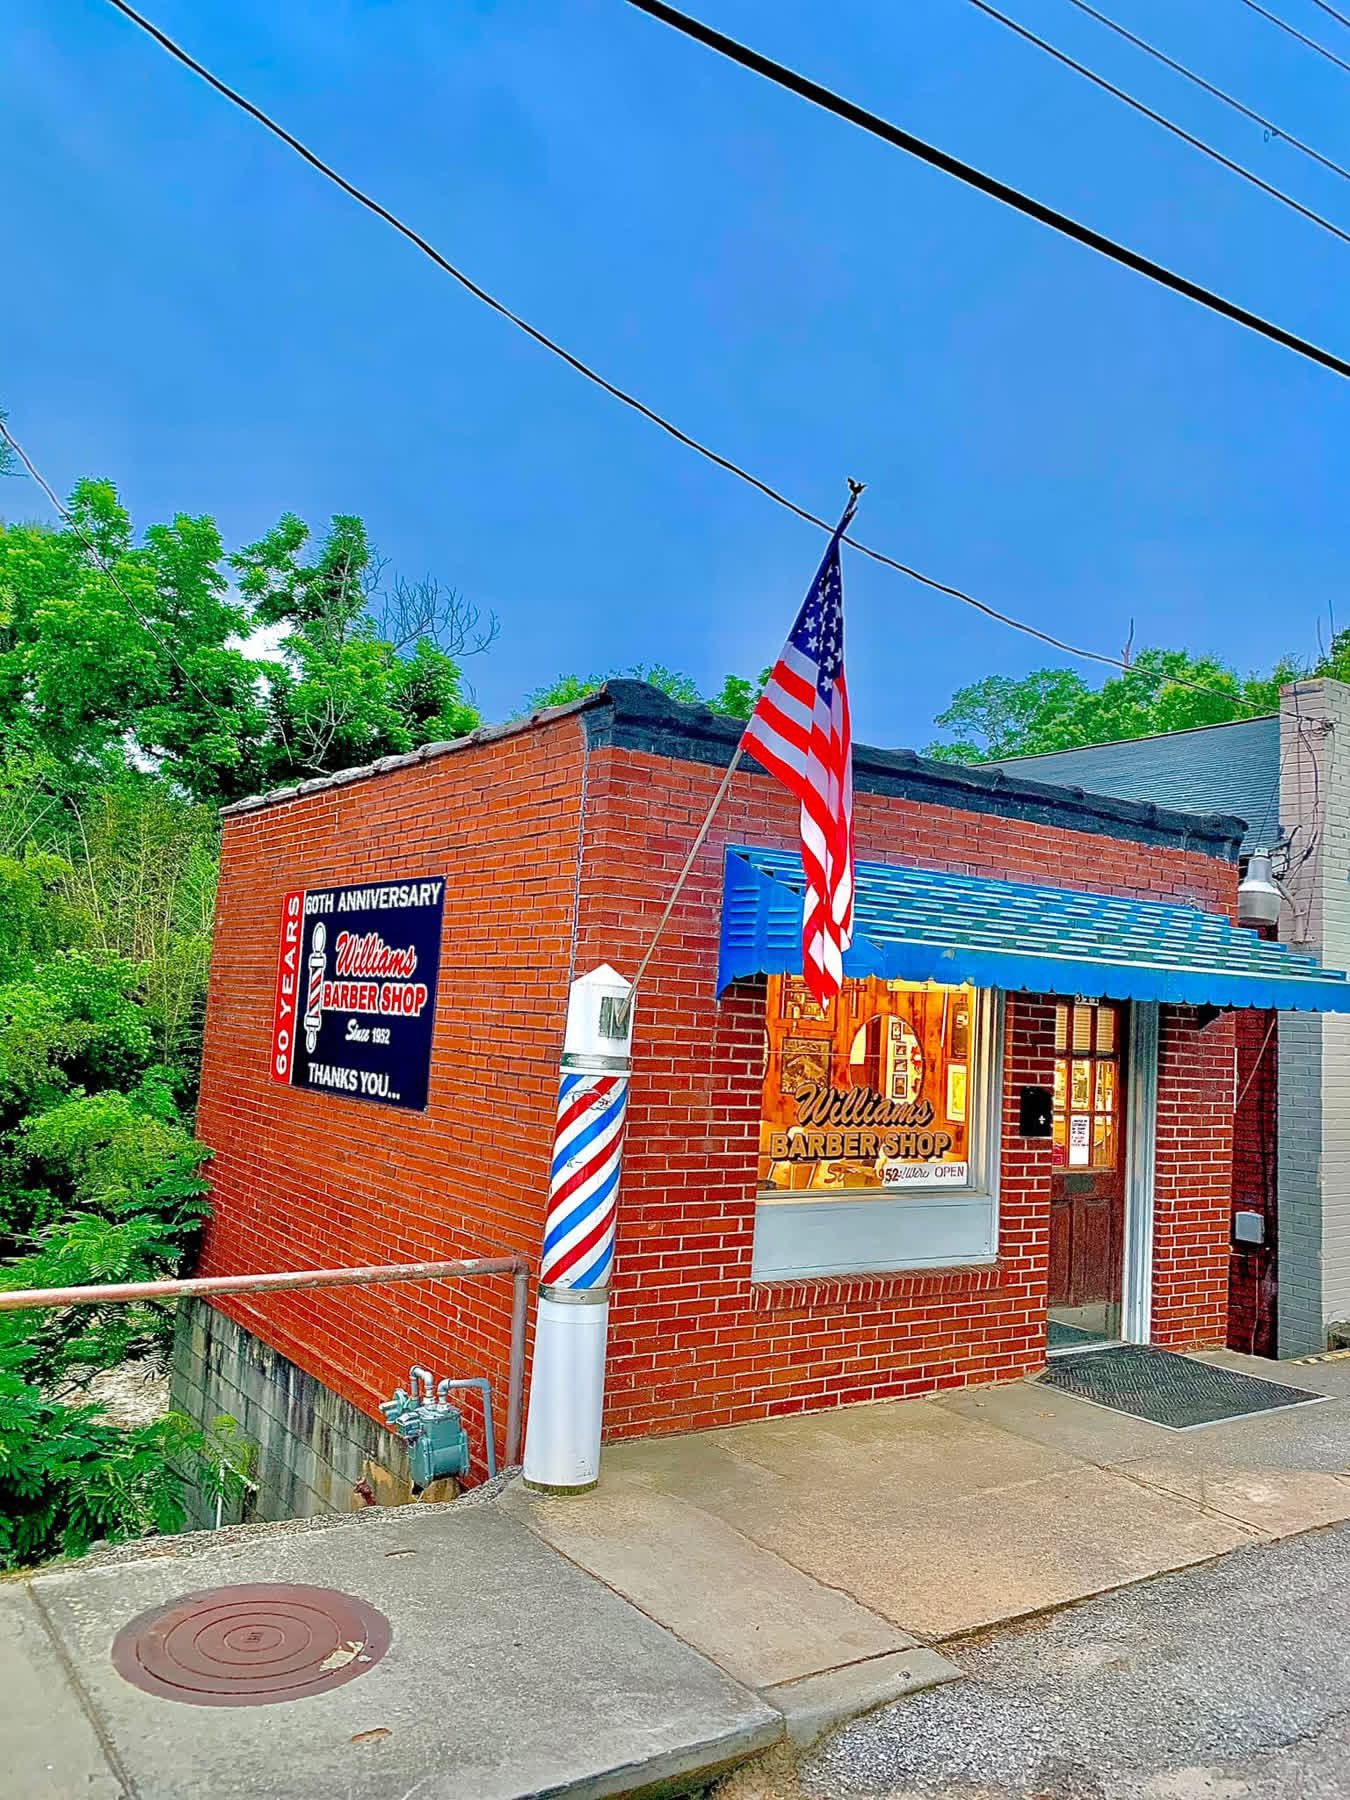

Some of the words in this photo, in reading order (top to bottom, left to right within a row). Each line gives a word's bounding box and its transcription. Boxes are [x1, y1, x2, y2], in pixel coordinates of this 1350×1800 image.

[305, 893, 334, 915] 60TH
[337, 882, 442, 912] ANNIVERSARY
[279, 895, 300, 1020] YEARS
[336, 931, 416, 978] Williams
[322, 981, 379, 1014] BARBER
[379, 982, 427, 1016] SHOP
[371, 1027, 391, 1045] 1952
[308, 1062, 358, 1090] THANKS
[360, 1071, 400, 1100] YOU...
[795, 1082, 934, 1128] Williams
[770, 1132, 879, 1160] BARBER
[883, 1131, 952, 1159] SHOP
[934, 1166, 965, 1178] OPEN
